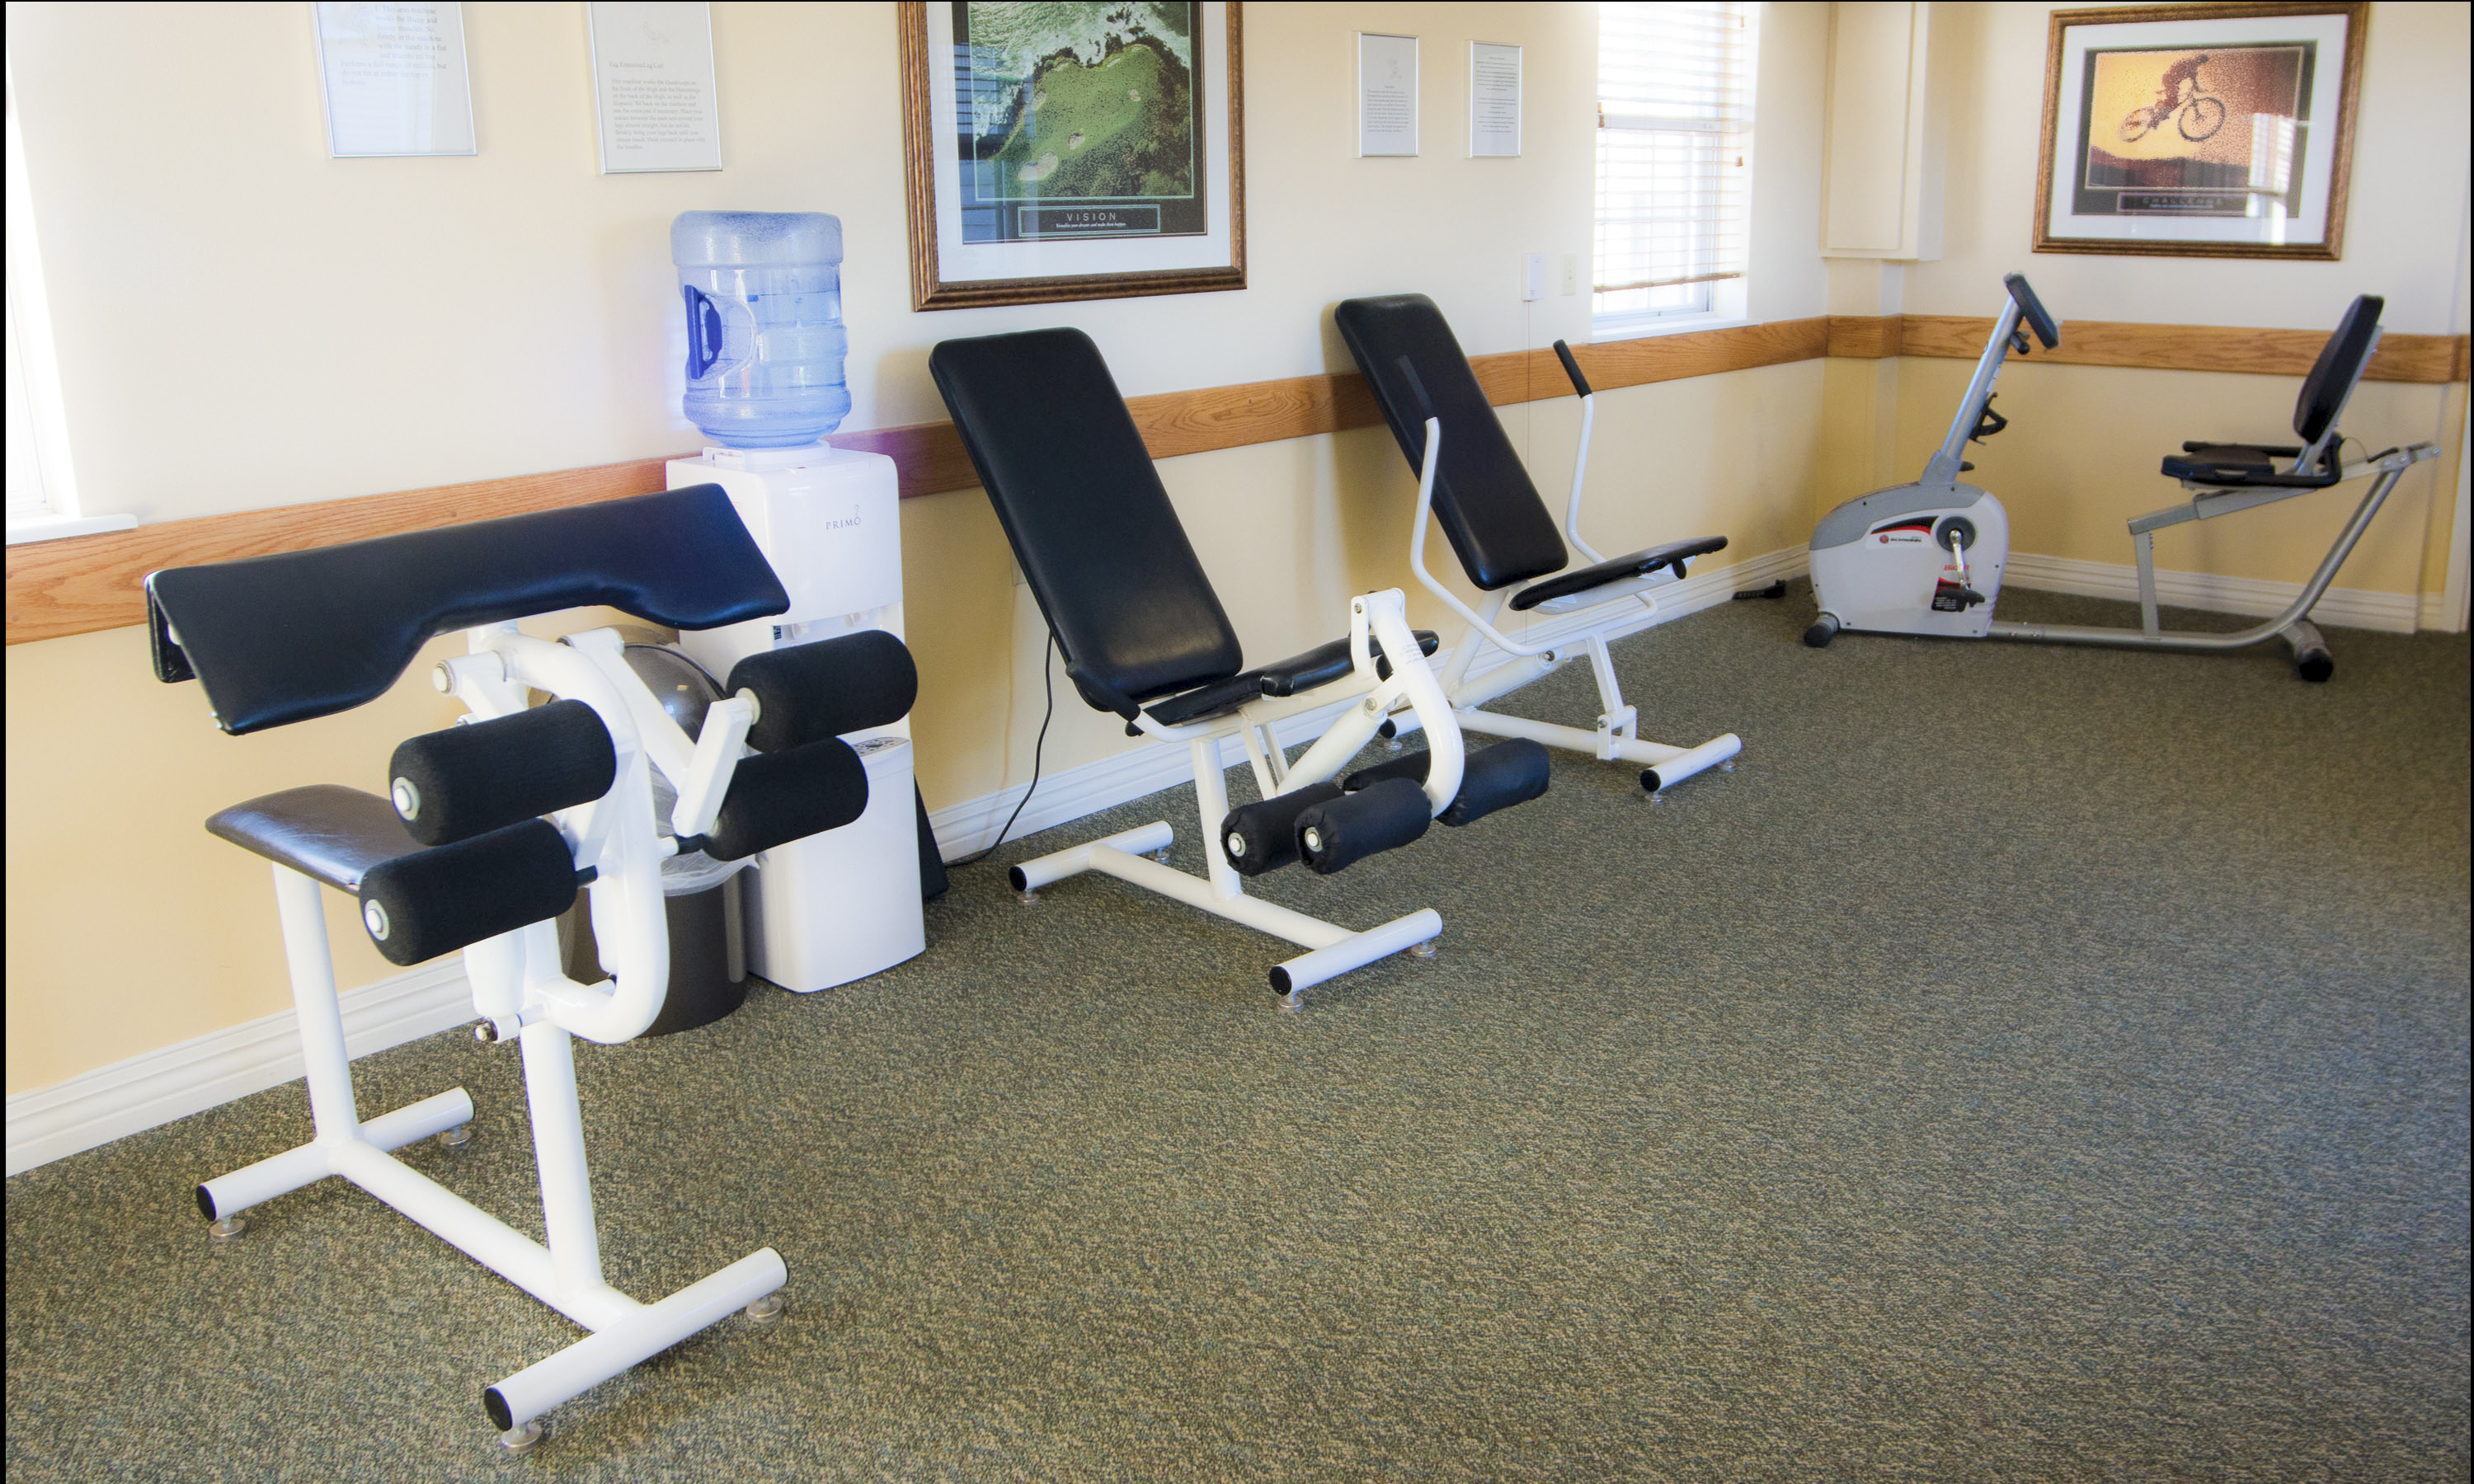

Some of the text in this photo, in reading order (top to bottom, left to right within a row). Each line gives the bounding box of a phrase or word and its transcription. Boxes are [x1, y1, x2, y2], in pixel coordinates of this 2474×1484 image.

[412, 6, 436, 15] machine
[406, 15, 426, 25] Bicep
[426, 25, 435, 33] Sit
[377, 33, 396, 42] firmly
[416, 35, 442, 43] machine
[378, 42, 393, 50] with
[340, 59, 368, 68] Perform
[373, 59, 384, 68] full
[436, 61, 447, 69] but
[379, 69, 397, 77] either
[411, 71, 420, 79] top
[1066, 212, 1117, 222] VISION
[825, 516, 861, 530] PRIMO
